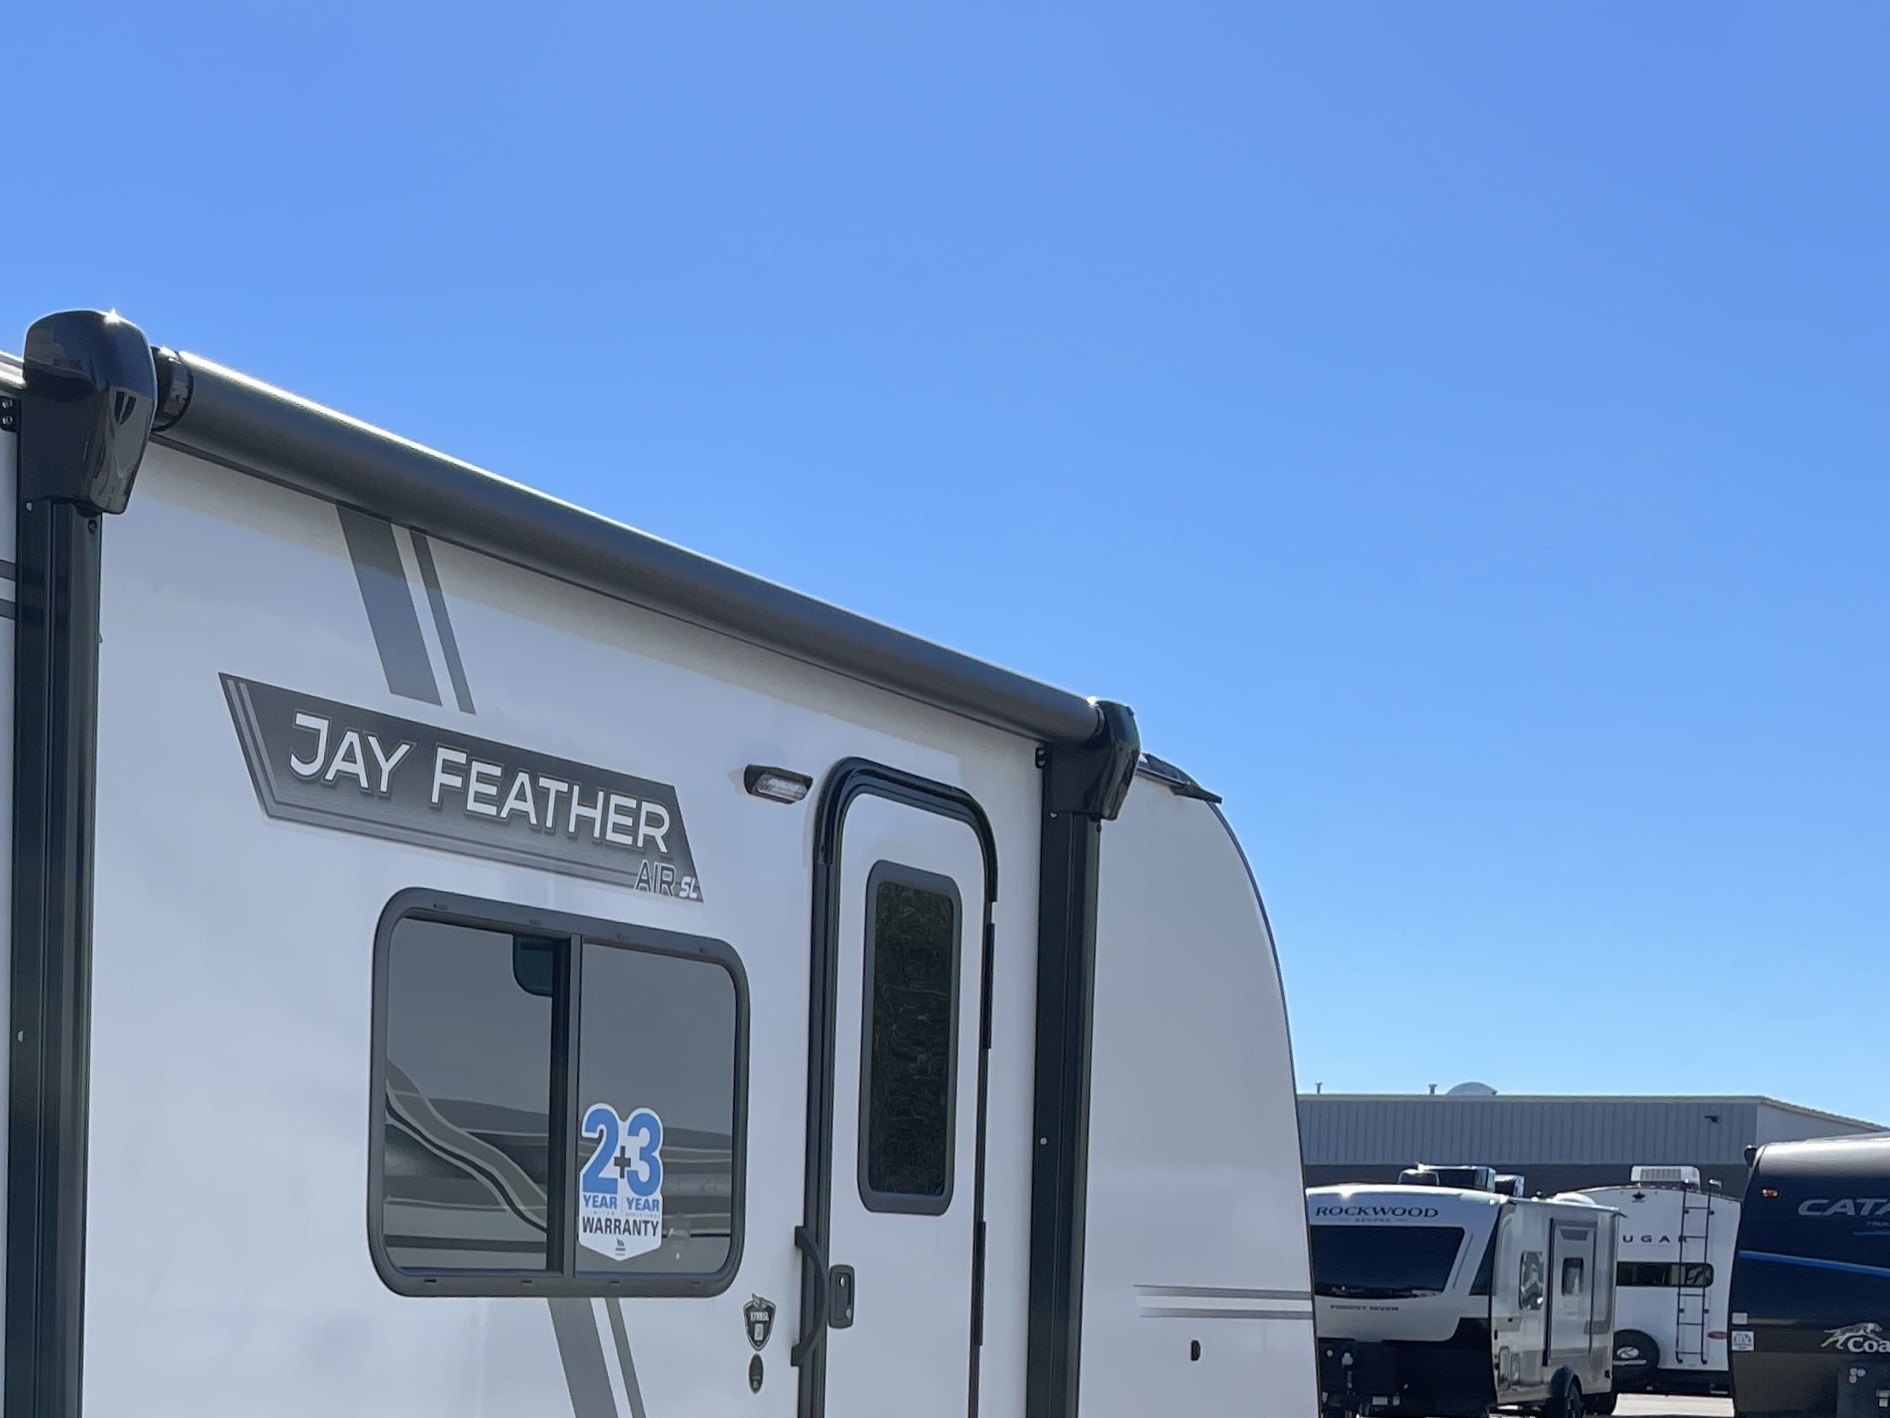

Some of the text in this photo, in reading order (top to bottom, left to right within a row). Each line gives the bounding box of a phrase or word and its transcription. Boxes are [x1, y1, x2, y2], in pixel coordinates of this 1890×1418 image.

[289, 711, 671, 854] JAY FEATHER
[634, 859, 698, 899] AIR SL
[583, 1194, 660, 1212] YEAR YEAR
[1316, 1206, 1439, 1218] ROCKWOOD
[582, 1216, 659, 1237] WARRANTY
